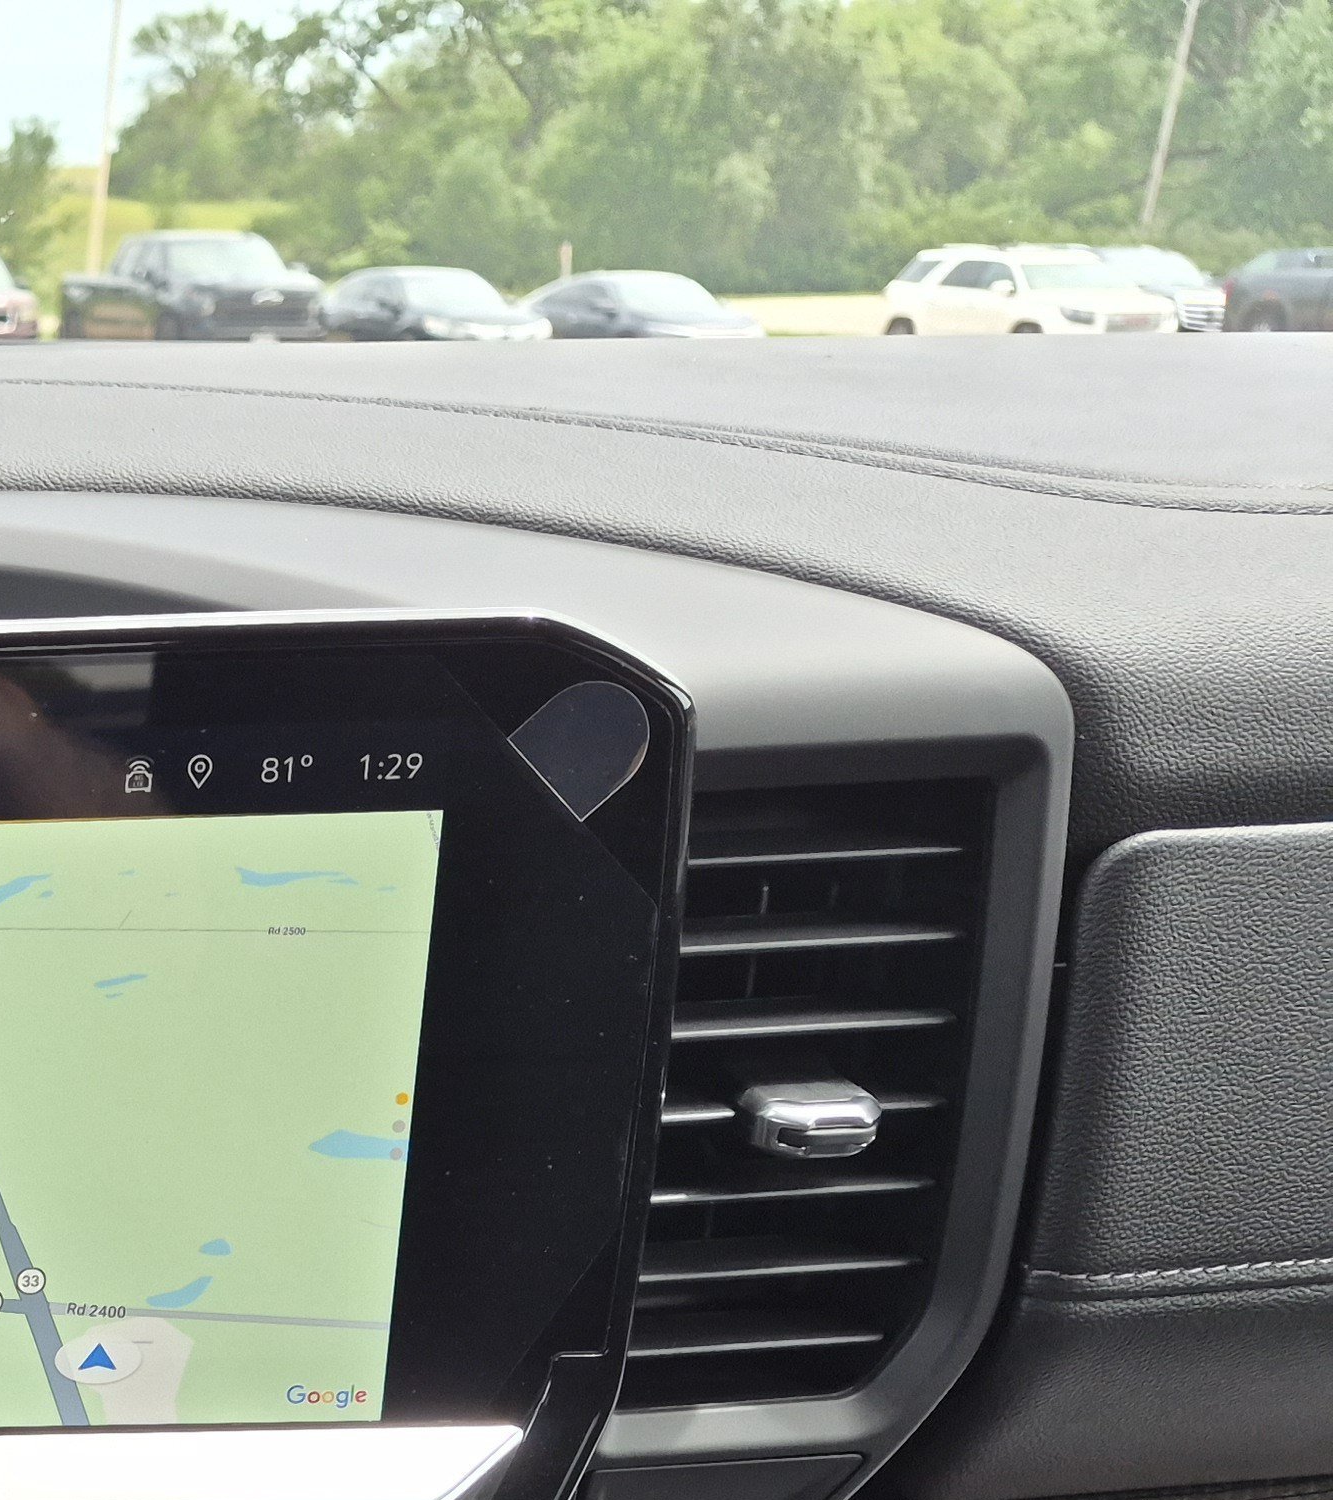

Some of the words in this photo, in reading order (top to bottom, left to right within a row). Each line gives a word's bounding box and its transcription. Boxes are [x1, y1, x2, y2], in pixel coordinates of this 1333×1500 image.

[359, 753, 423, 781] 1:29
[268, 926, 281, 937] Rd
[283, 926, 307, 937] 2500
[21, 1275, 40, 1287] 33
[66, 1302, 86, 1317] Rd
[88, 1304, 126, 1319] 2400
[286, 1384, 368, 1410] Google
